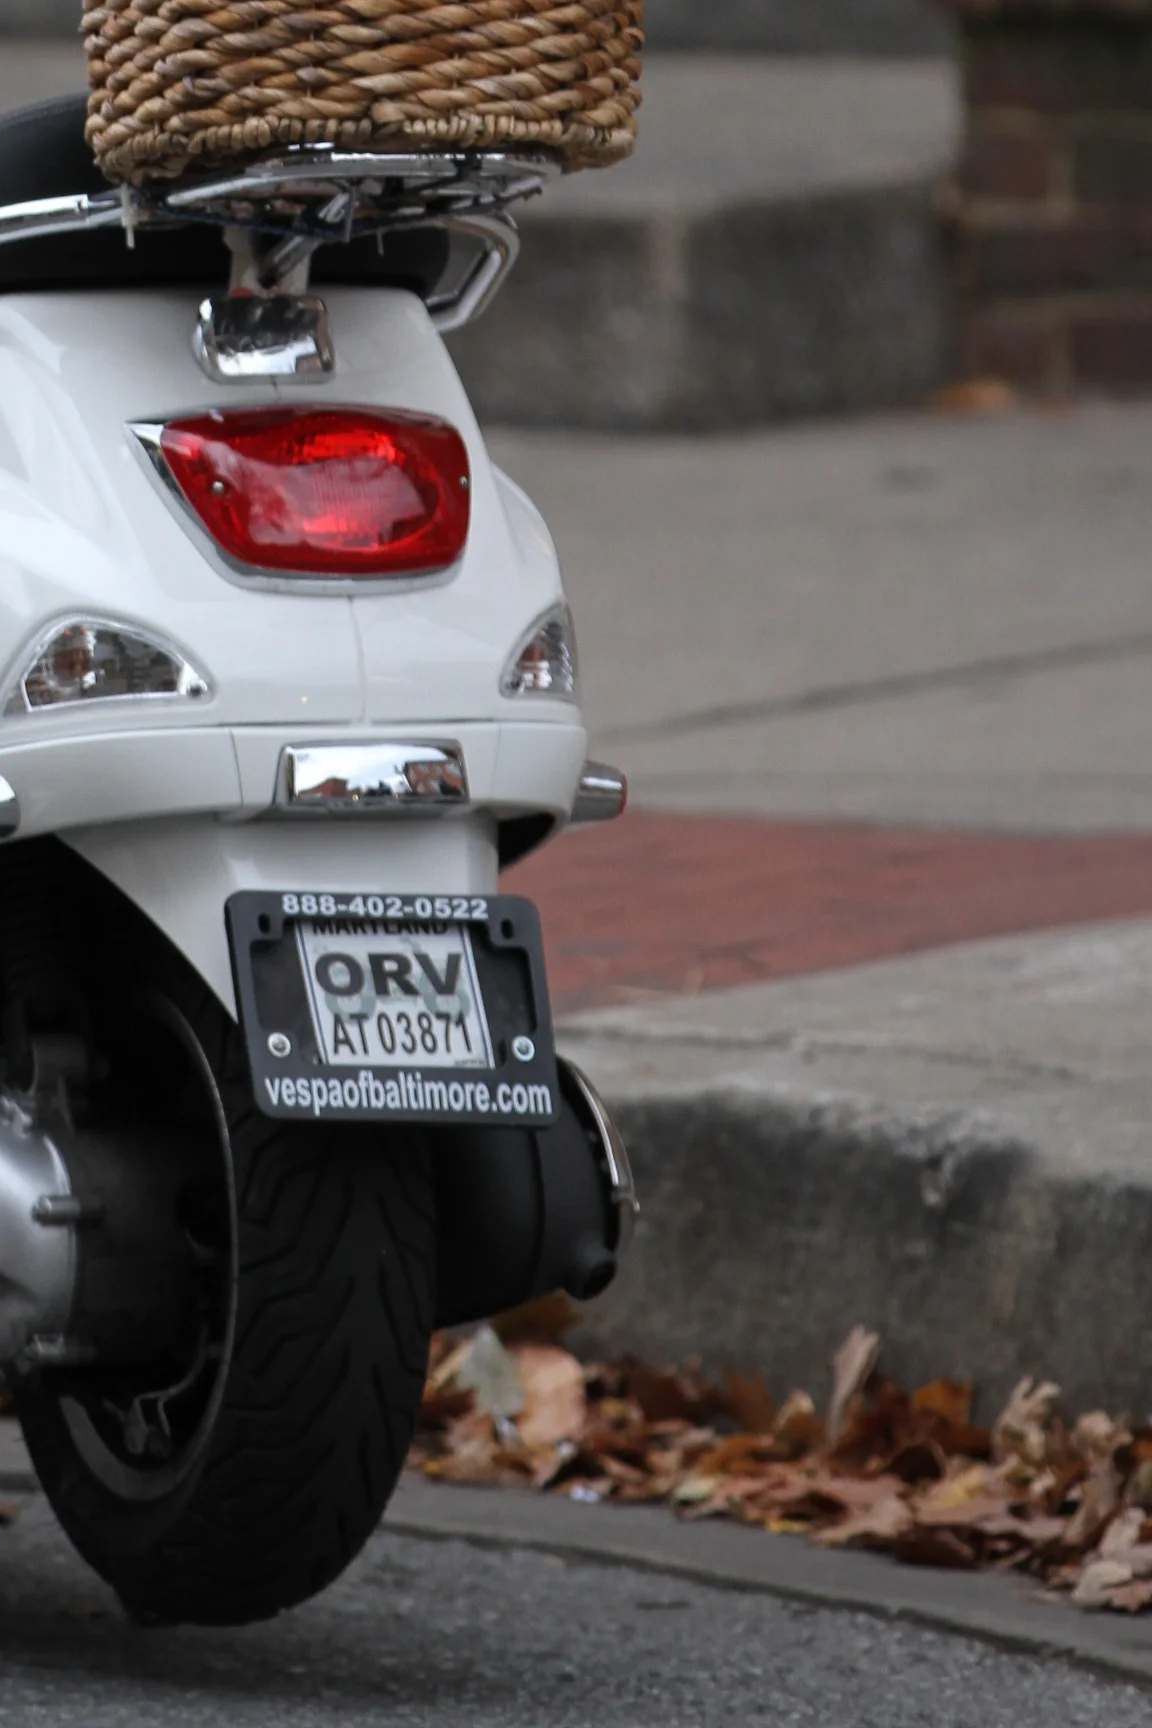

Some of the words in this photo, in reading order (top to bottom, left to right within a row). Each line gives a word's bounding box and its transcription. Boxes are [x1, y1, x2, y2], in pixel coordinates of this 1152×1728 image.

[282, 894, 489, 920] 888-402-0522
[314, 953, 463, 997] ORV
[265, 1070, 552, 1116] vespaofbaltimore.com
